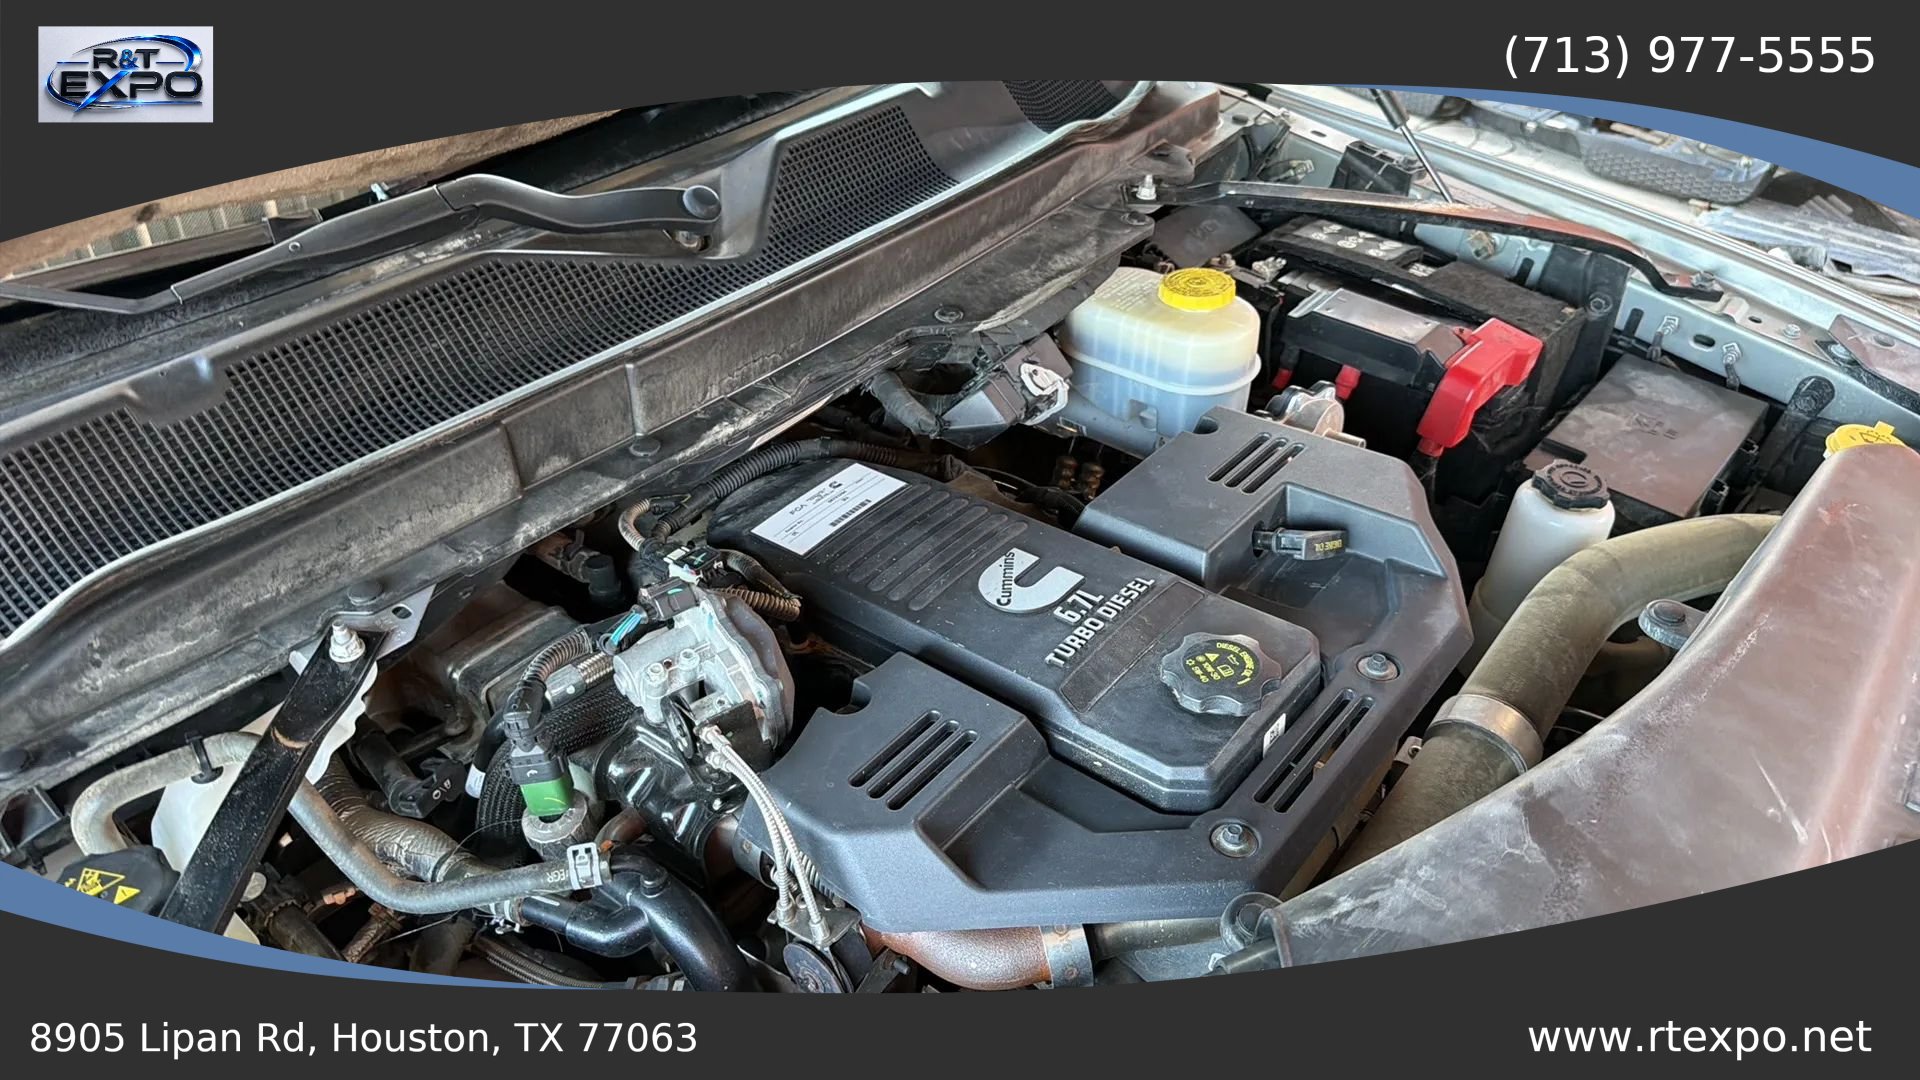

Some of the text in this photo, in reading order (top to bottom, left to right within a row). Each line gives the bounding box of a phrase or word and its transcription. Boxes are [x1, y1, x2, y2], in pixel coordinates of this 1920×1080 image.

[996, 551, 1015, 607] Cummins
[1045, 577, 1156, 668] TURBO DIESEL
[1053, 589, 1104, 626] 6.7L
[1216, 642, 1241, 654] DIESEL
